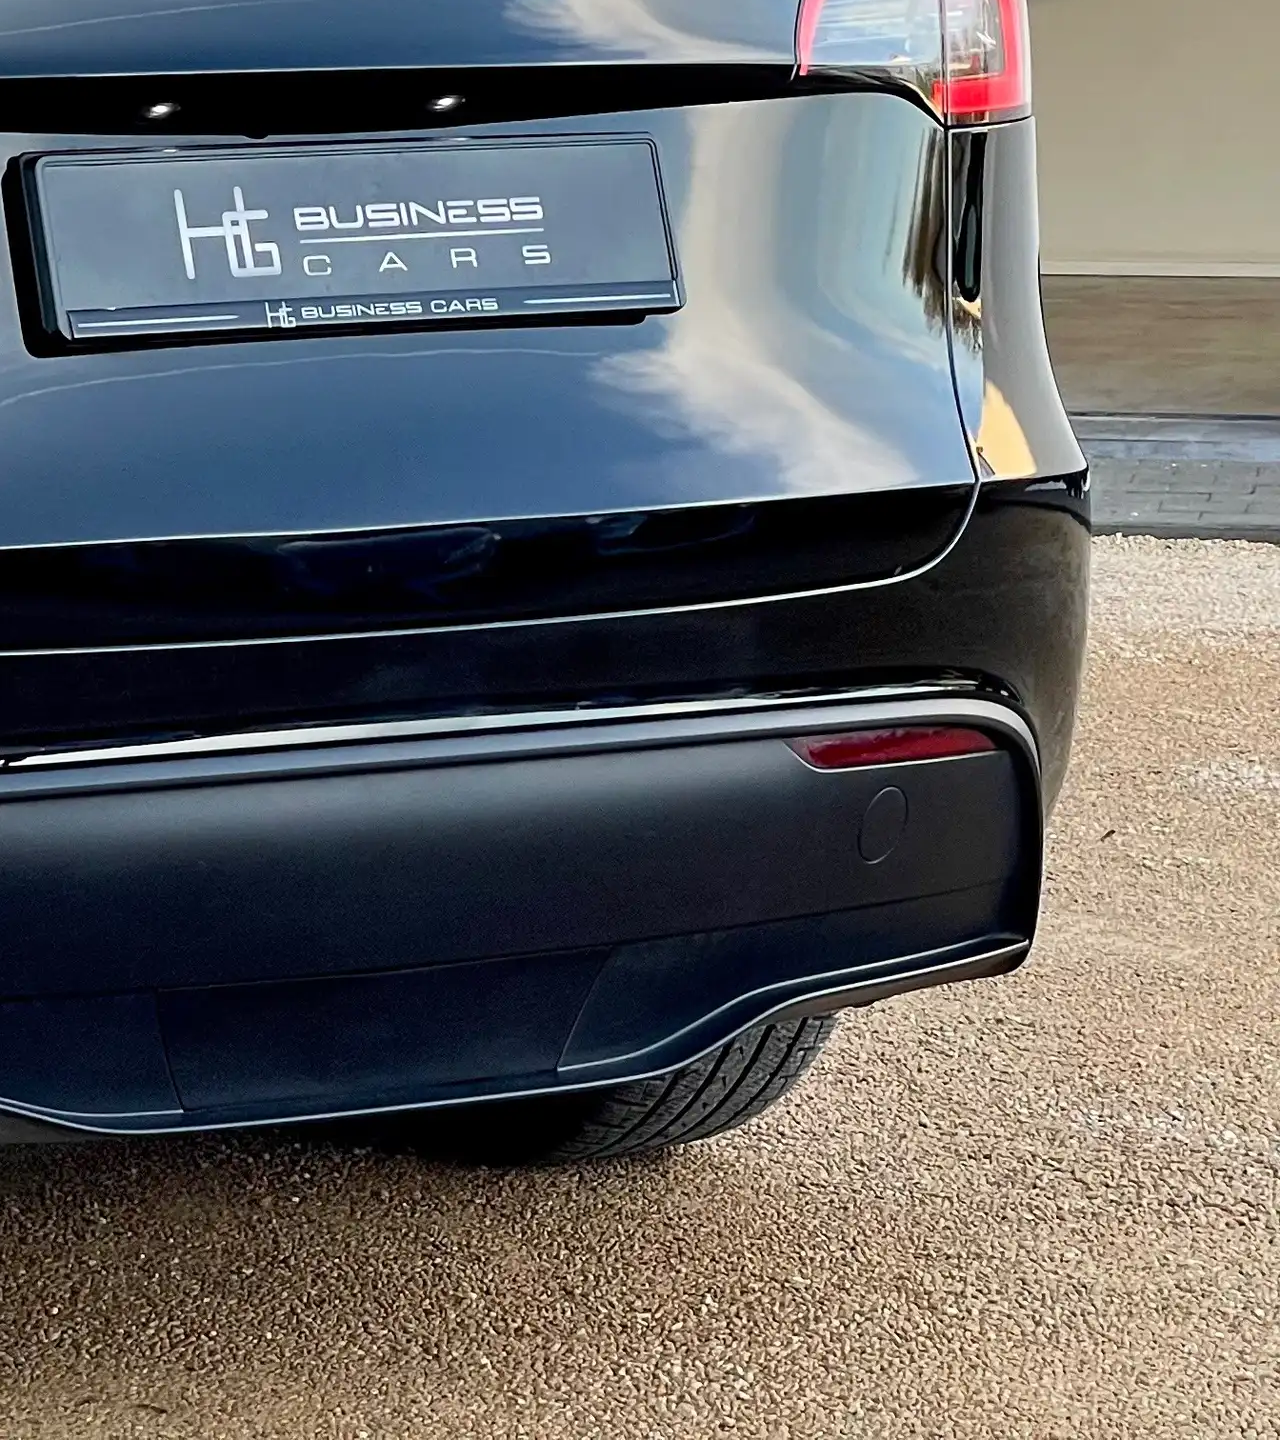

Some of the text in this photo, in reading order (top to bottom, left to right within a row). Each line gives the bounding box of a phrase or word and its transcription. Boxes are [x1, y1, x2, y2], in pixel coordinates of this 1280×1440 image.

[293, 196, 544, 231] BUSINESS
[300, 301, 423, 320] BUSINESS
[429, 297, 499, 314] CARS
